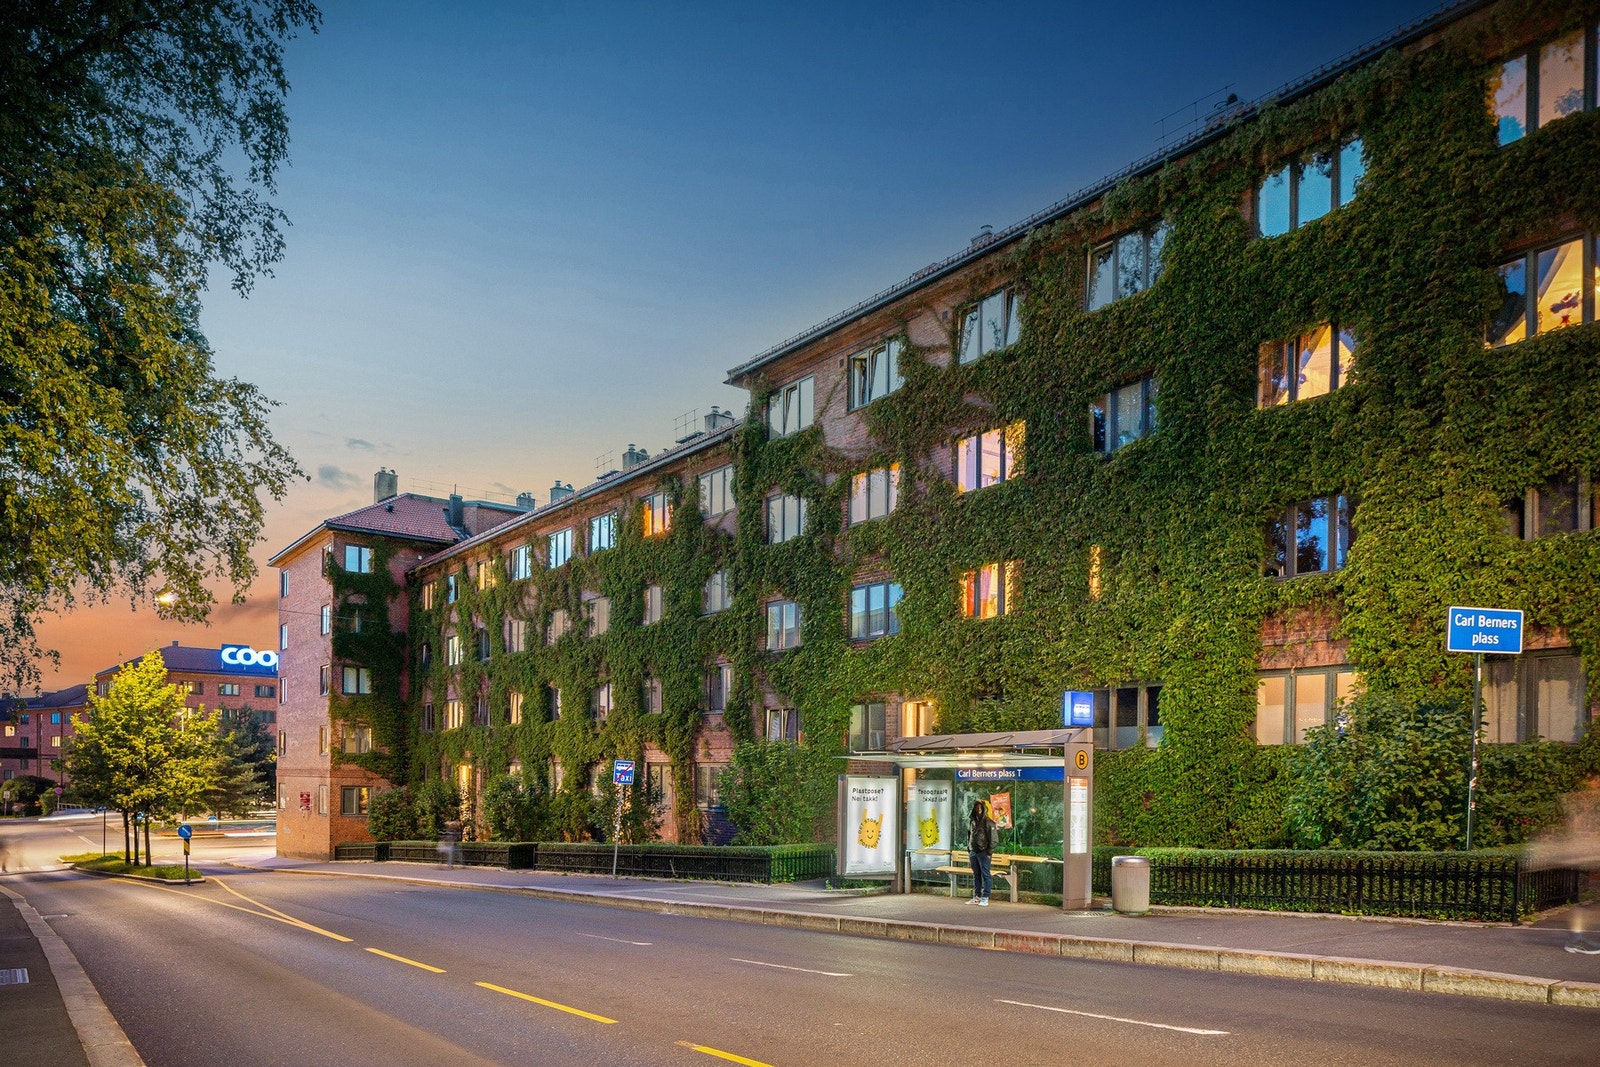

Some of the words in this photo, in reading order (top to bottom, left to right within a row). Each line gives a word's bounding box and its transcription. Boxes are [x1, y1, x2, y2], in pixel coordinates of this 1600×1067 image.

[1454, 613, 1475, 627] Carl
[1478, 615, 1518, 629] Berners
[1472, 632, 1499, 646] plass
[221, 647, 279, 671] coo
[616, 772, 632, 782] Taxi
[958, 769, 971, 778] Carl
[972, 769, 997, 778] Berners
[998, 769, 1015, 779] plass
[1017, 769, 1022, 777] T
[852, 787, 884, 795] Plastpose?
